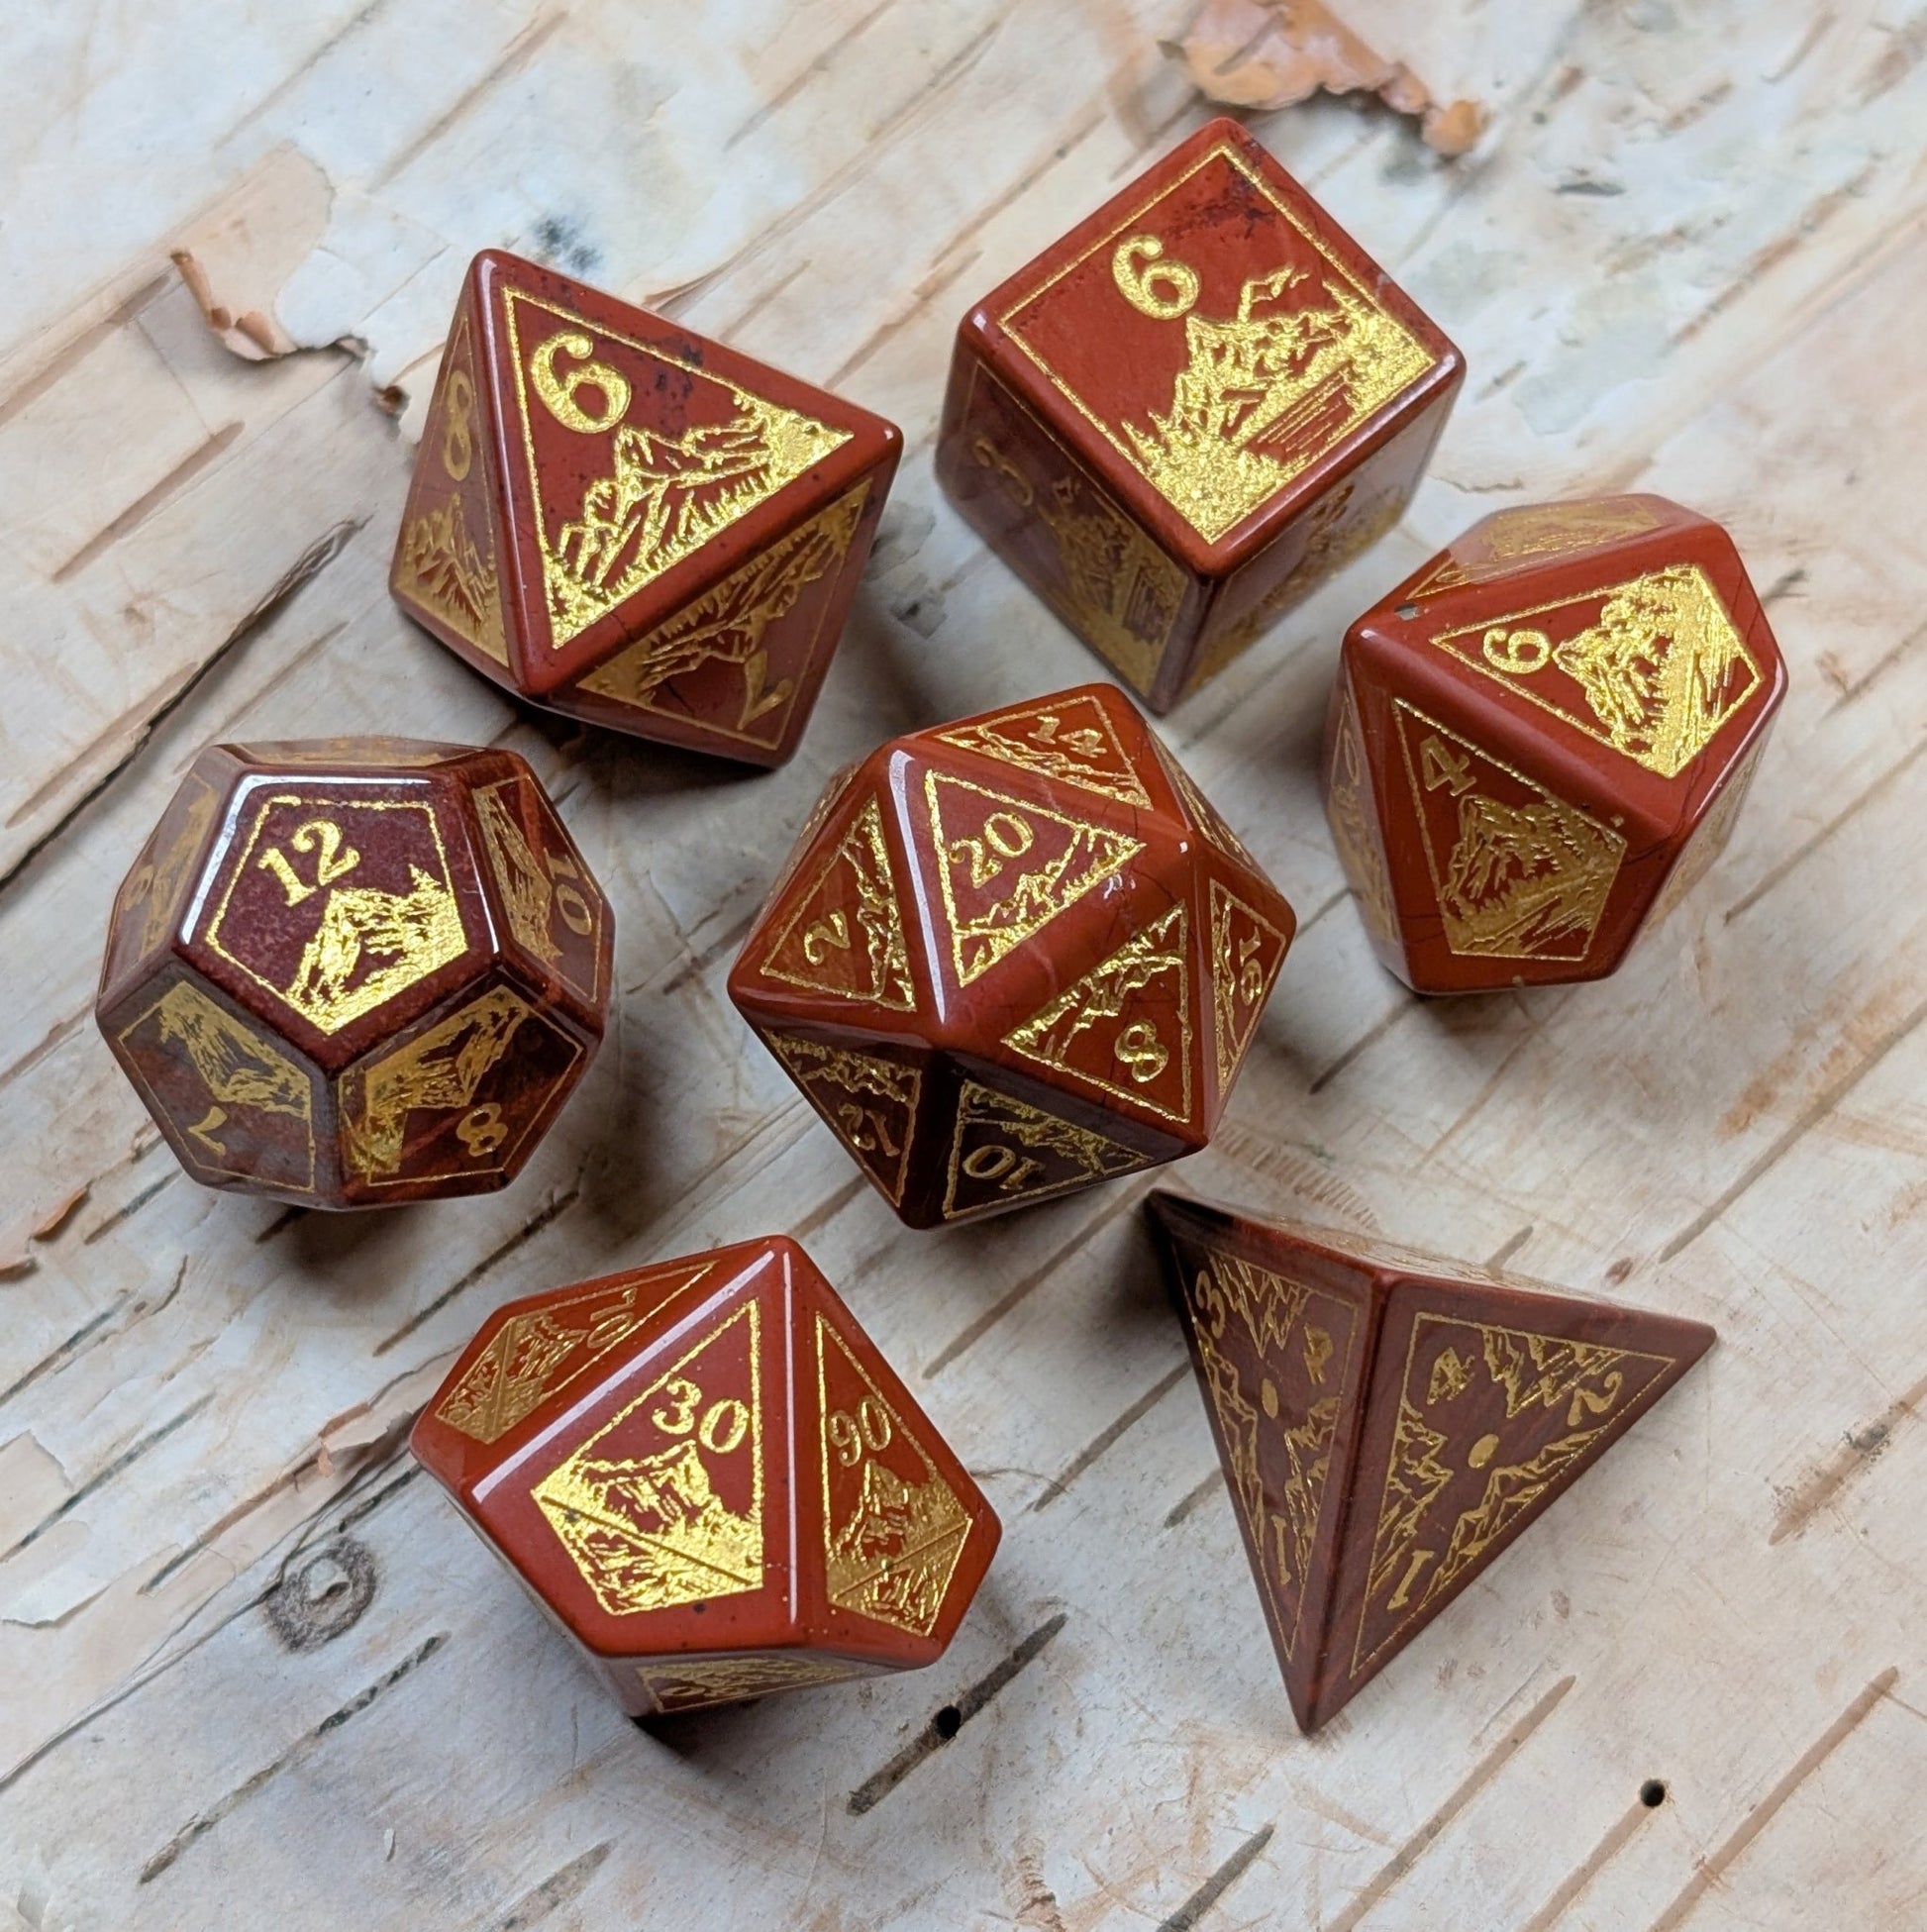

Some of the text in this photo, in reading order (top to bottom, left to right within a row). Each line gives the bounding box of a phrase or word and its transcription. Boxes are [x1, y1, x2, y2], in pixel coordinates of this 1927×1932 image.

[1112, 235, 1199, 320] 6
[531, 332, 632, 434] 6
[445, 370, 471, 482] 8
[1482, 628, 1551, 673] 6
[737, 647, 793, 731] 7
[1028, 714, 1107, 759] 14
[1421, 734, 1477, 796] 4
[257, 817, 361, 907] 12
[949, 812, 1035, 888] 20
[543, 847, 593, 936] 10
[804, 909, 852, 966] 2
[1238, 926, 1265, 1007] 16
[1114, 1019, 1169, 1082] 8
[187, 1105, 228, 1157] 7
[455, 1102, 509, 1158] 8
[839, 1102, 900, 1157] 12
[963, 1145, 1045, 1189] 10
[586, 1287, 638, 1349] 70
[1195, 1270, 1225, 1339] 3
[652, 1378, 749, 1455] 30
[828, 1394, 892, 1466] 90
[1568, 1371, 1622, 1426] 2
[1270, 1515, 1292, 1585] 1
[1387, 1550, 1436, 1610] 1
